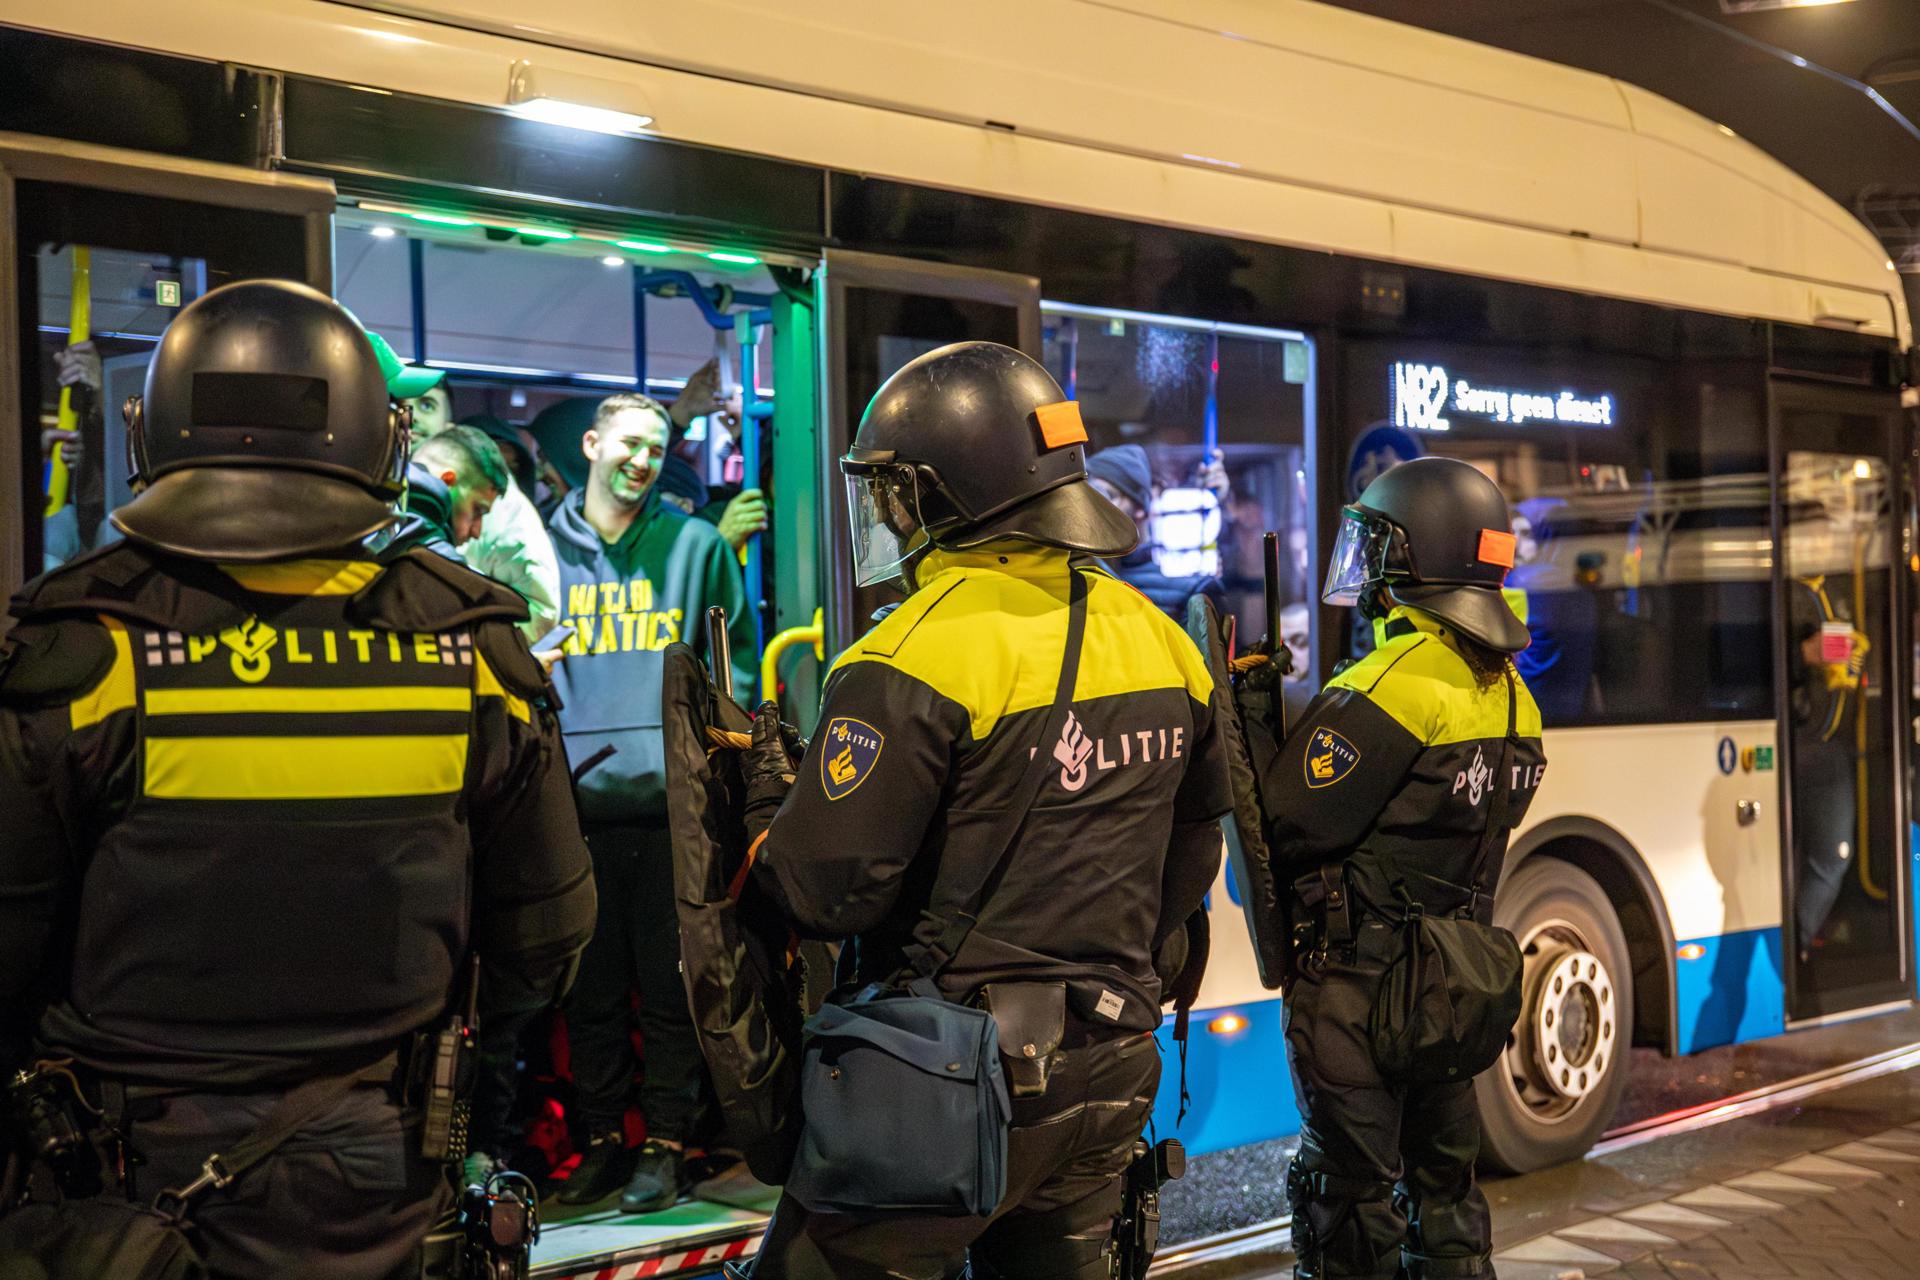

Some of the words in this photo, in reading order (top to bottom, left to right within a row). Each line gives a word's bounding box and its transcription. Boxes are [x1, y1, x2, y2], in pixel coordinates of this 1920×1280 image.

[1395, 361, 1450, 431] N82
[1455, 380, 1509, 422] Sorry
[1510, 393, 1554, 423] geen
[1556, 391, 1612, 425] dienst
[188, 613, 440, 684] POLITIE
[562, 608, 683, 656] ANATICS
[832, 722, 877, 750] POLITIE
[1030, 710, 1184, 792] OLITIE
[1317, 733, 1355, 762] POLITIE
[1452, 745, 1546, 806] POLTIE
